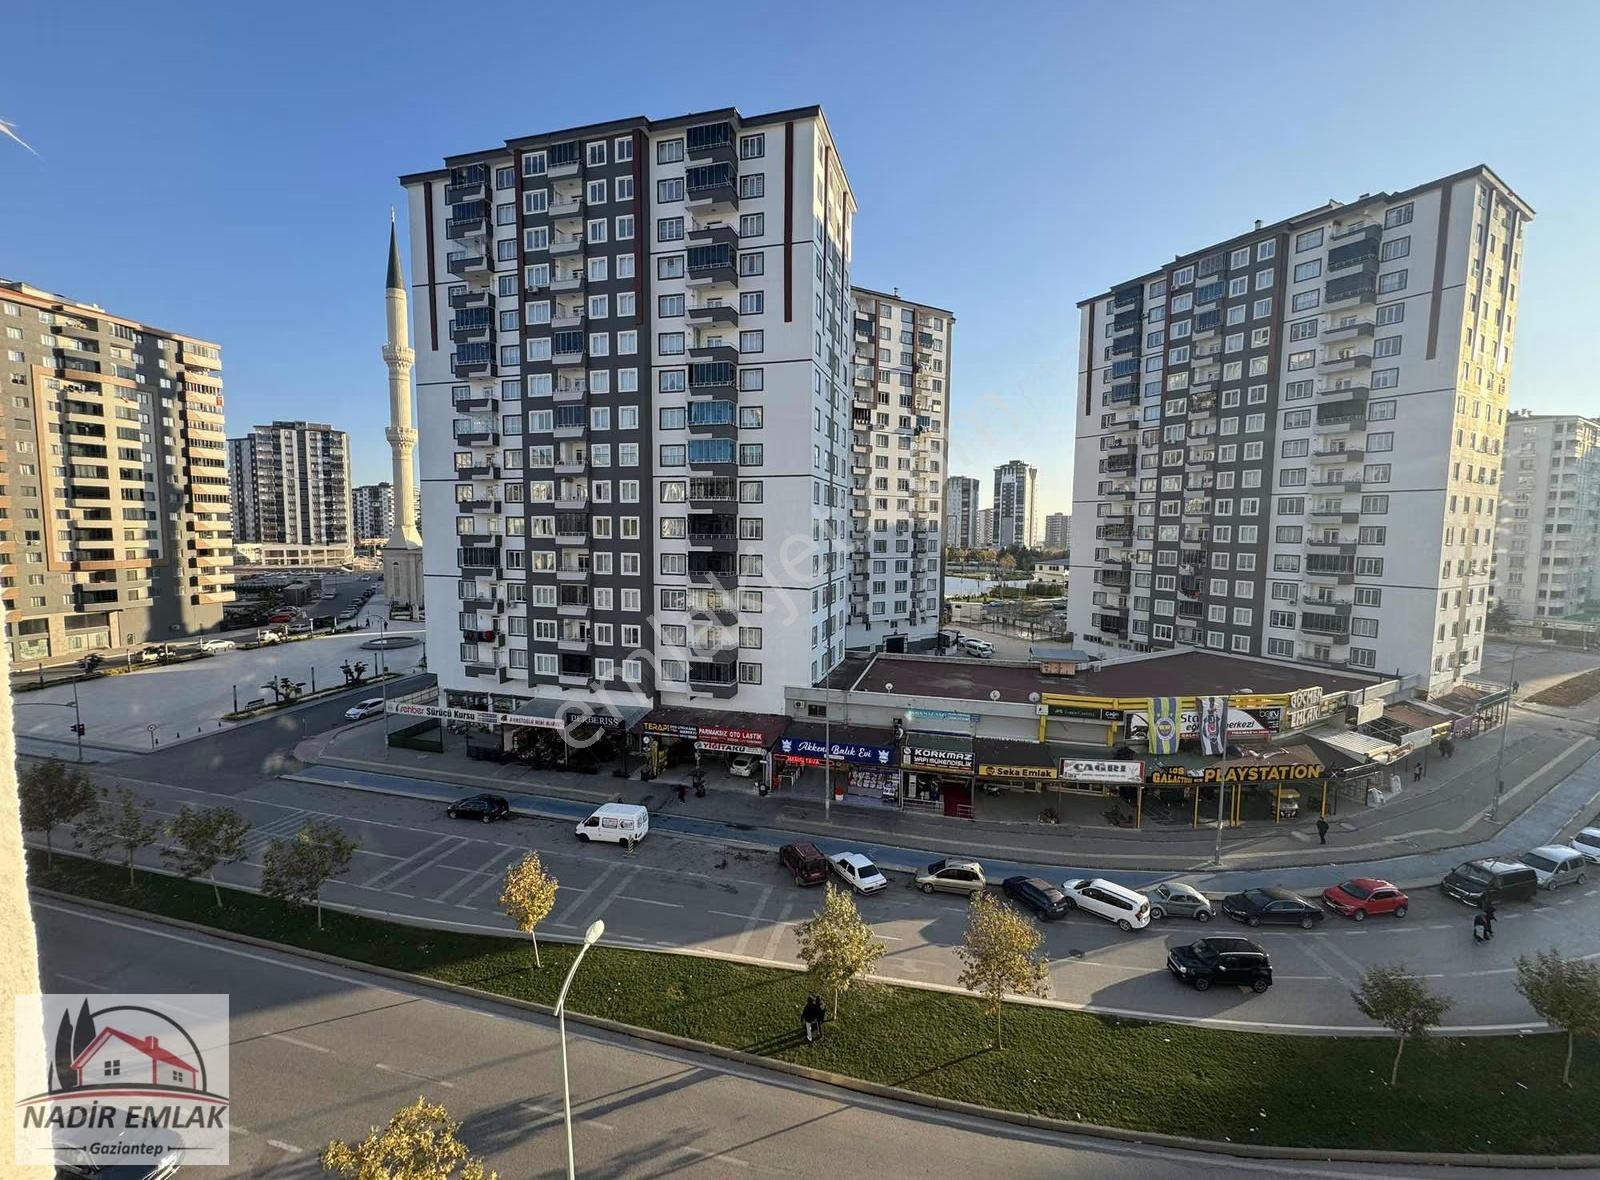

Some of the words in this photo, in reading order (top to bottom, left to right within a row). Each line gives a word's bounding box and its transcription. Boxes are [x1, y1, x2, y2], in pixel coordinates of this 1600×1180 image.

[400, 705, 424, 714] rehber
[426, 707, 452, 717] Sürücü
[454, 711, 475, 720] Kursu
[1291, 706, 1319, 728] EMLAK
[797, 741, 828, 753] Akken
[831, 744, 856, 756] Balık
[858, 748, 872, 758] Evi
[914, 749, 972, 760] KORKMAZ
[1022, 769, 1052, 777] Emlak
[1169, 767, 1184, 775] LOS
[1204, 764, 1321, 782] PLAYSTATION
